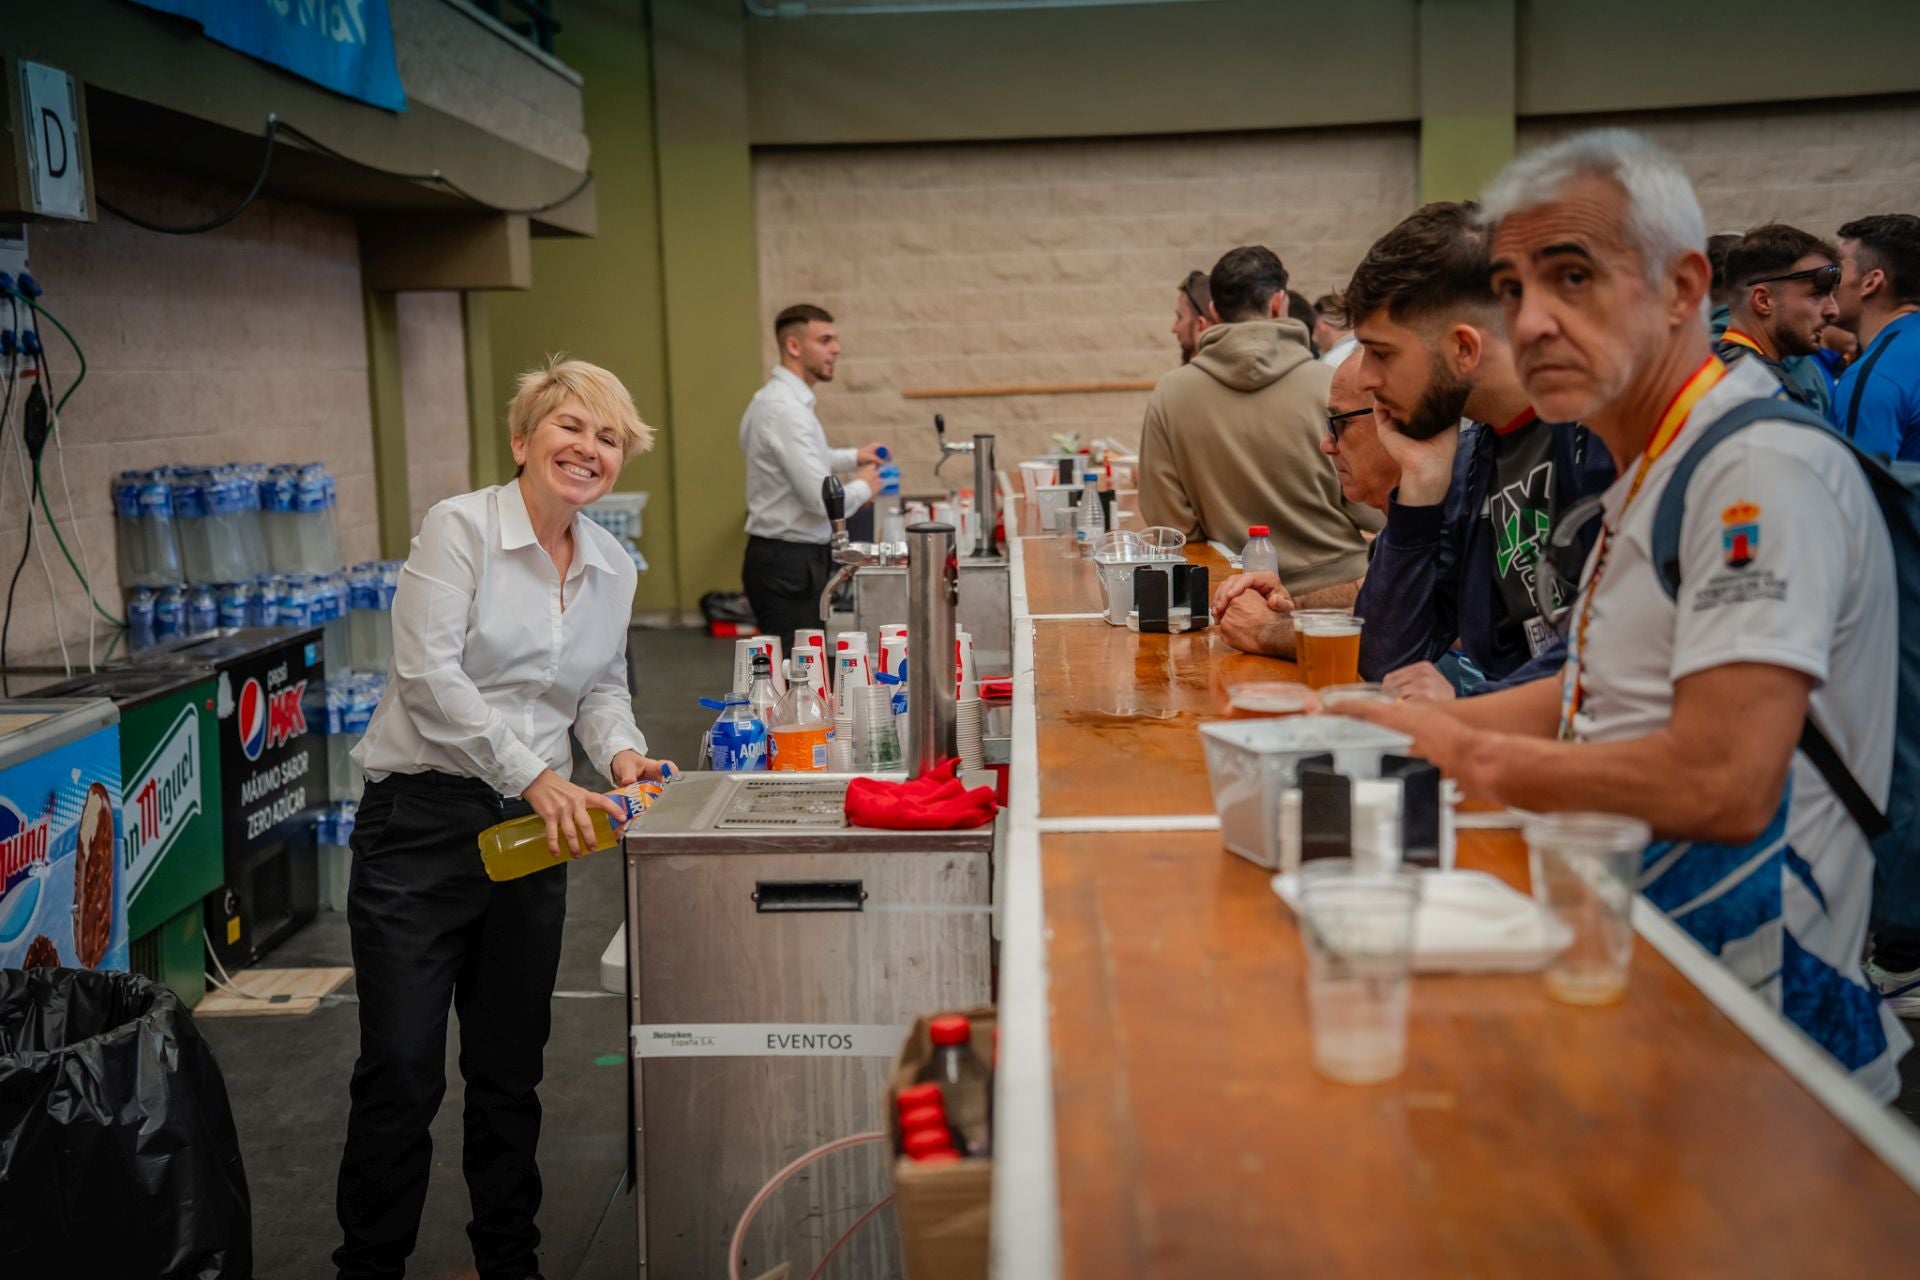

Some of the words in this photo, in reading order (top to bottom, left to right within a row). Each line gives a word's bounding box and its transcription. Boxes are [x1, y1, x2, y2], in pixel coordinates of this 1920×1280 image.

[41, 106, 68, 178] D
[267, 679, 308, 749] MAX
[136, 733, 194, 847] Miguel
[241, 765, 281, 807] MÁXIMO
[281, 750, 309, 785] SABOR
[246, 806, 272, 840] ZERO
[272, 787, 306, 826] AZÚCAR
[653, 1031, 692, 1040] Heineken
[767, 1034, 853, 1049] EVENTOS
